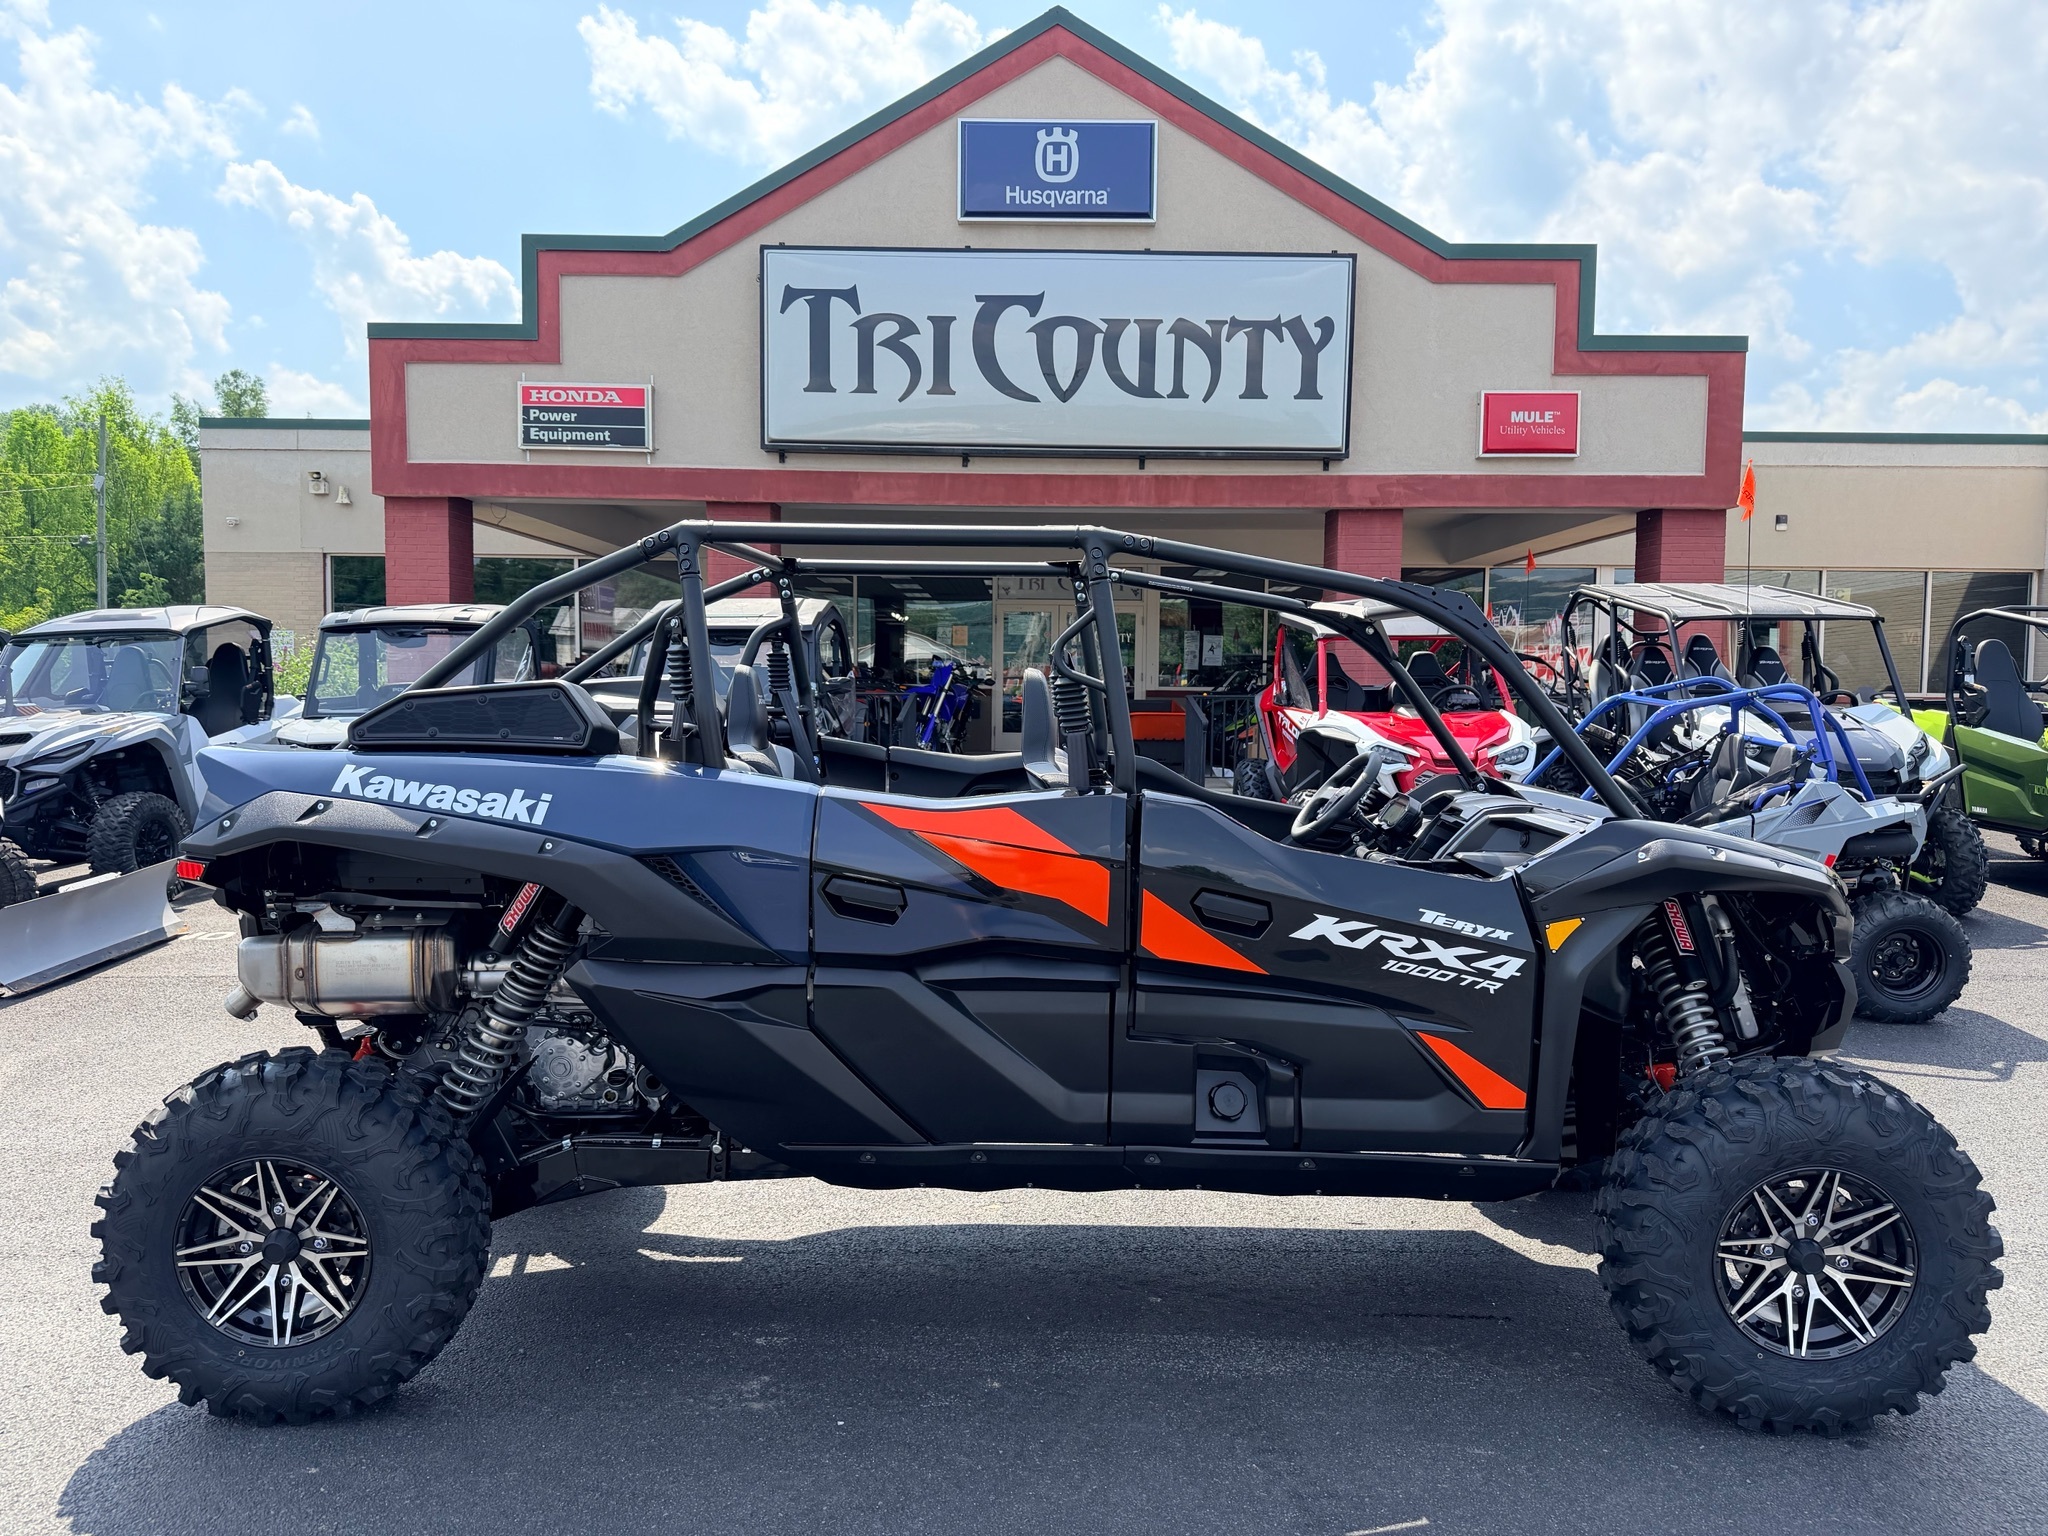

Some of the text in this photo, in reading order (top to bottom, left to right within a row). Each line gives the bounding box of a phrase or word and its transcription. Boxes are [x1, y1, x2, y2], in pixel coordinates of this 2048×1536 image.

[1005, 186, 1108, 208] Husqvarna
[780, 283, 1336, 403] TRI COUNTY
[529, 389, 623, 403] HONDA
[529, 408, 578, 422] Power
[1499, 425, 1566, 437] Utility Vehicles
[529, 427, 611, 443] Equipment
[331, 764, 553, 826] Kawasaki
[503, 882, 540, 932] SHOWA
[1664, 901, 1694, 950] SHOWA
[1288, 913, 1527, 980] KRX4
